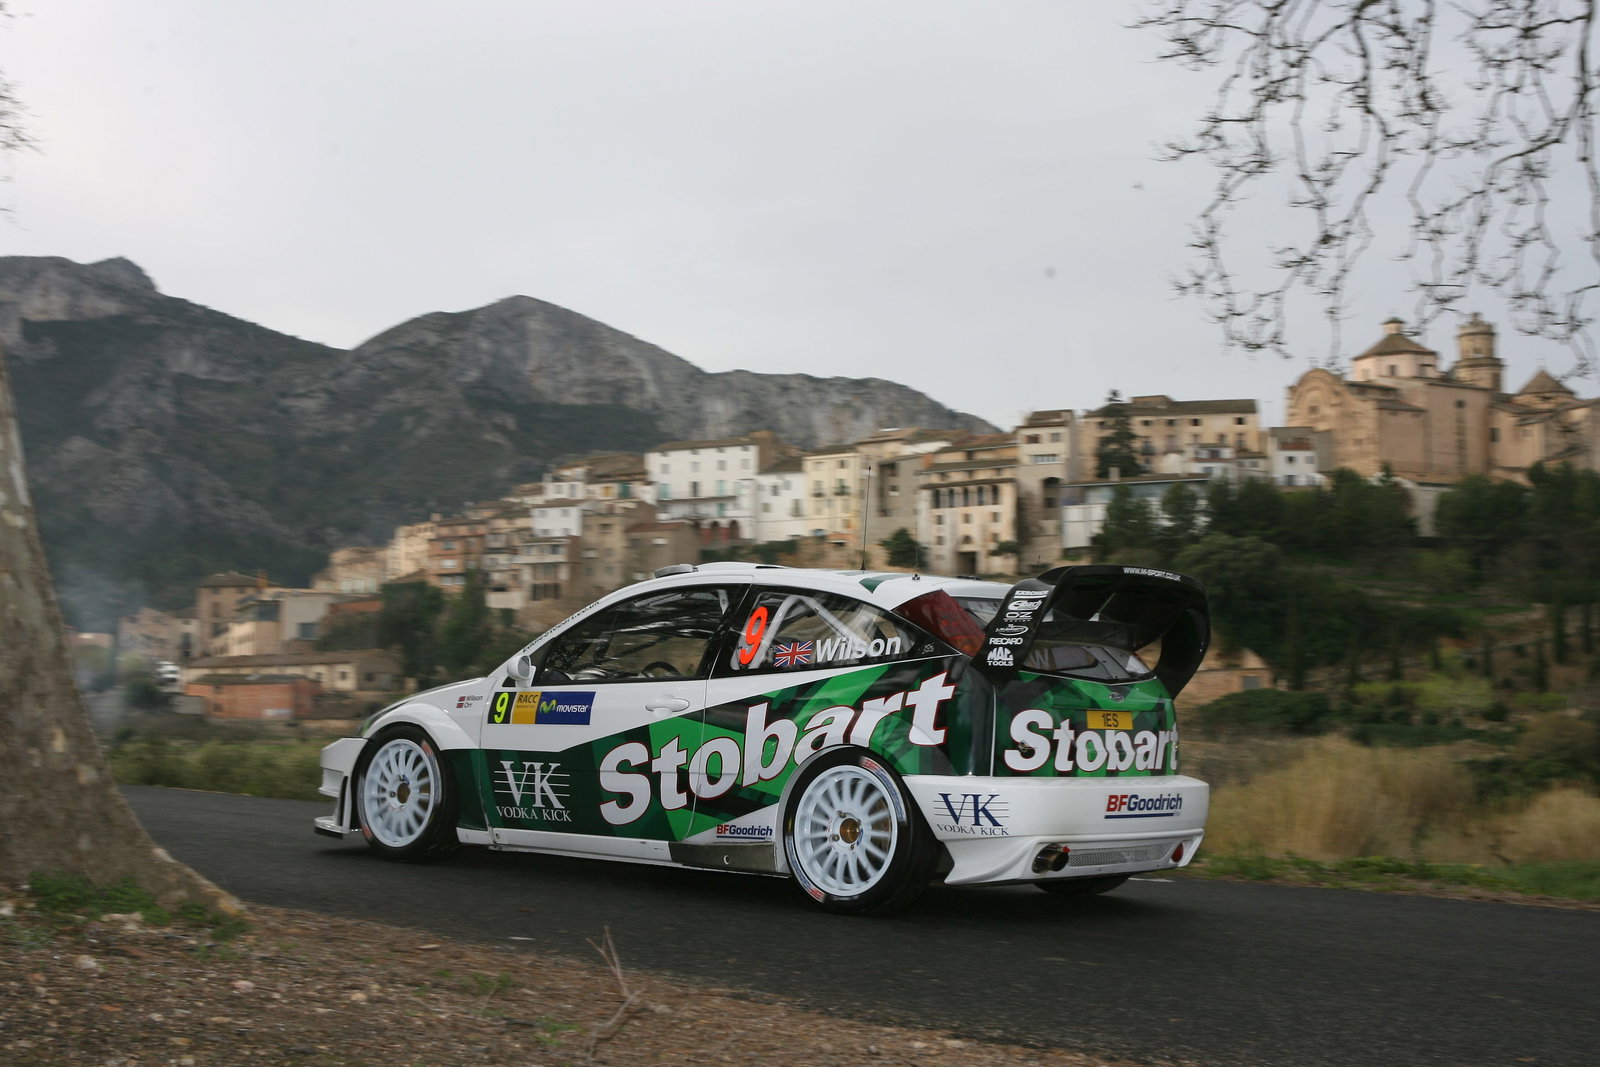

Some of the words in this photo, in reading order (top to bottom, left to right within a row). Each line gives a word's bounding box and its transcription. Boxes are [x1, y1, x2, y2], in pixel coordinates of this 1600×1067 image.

[739, 606, 768, 665] 9
[989, 637, 1023, 645] RECARO
[816, 636, 900, 662] Wilson
[987, 647, 1014, 660] MAC
[493, 692, 509, 723] 9
[517, 694, 539, 704] RACC
[556, 704, 589, 713] movistar
[599, 670, 958, 826] Stobart
[1004, 709, 1180, 772] Stobart
[500, 761, 566, 809] VK
[938, 792, 1004, 827] VK
[1106, 793, 1183, 812] BFGoodrich
[496, 806, 538, 820] VODKA
[542, 809, 572, 822] KICK
[716, 824, 773, 836] BFGoodrich
[937, 823, 976, 835] VODKA
[981, 827, 1010, 836] KICK
